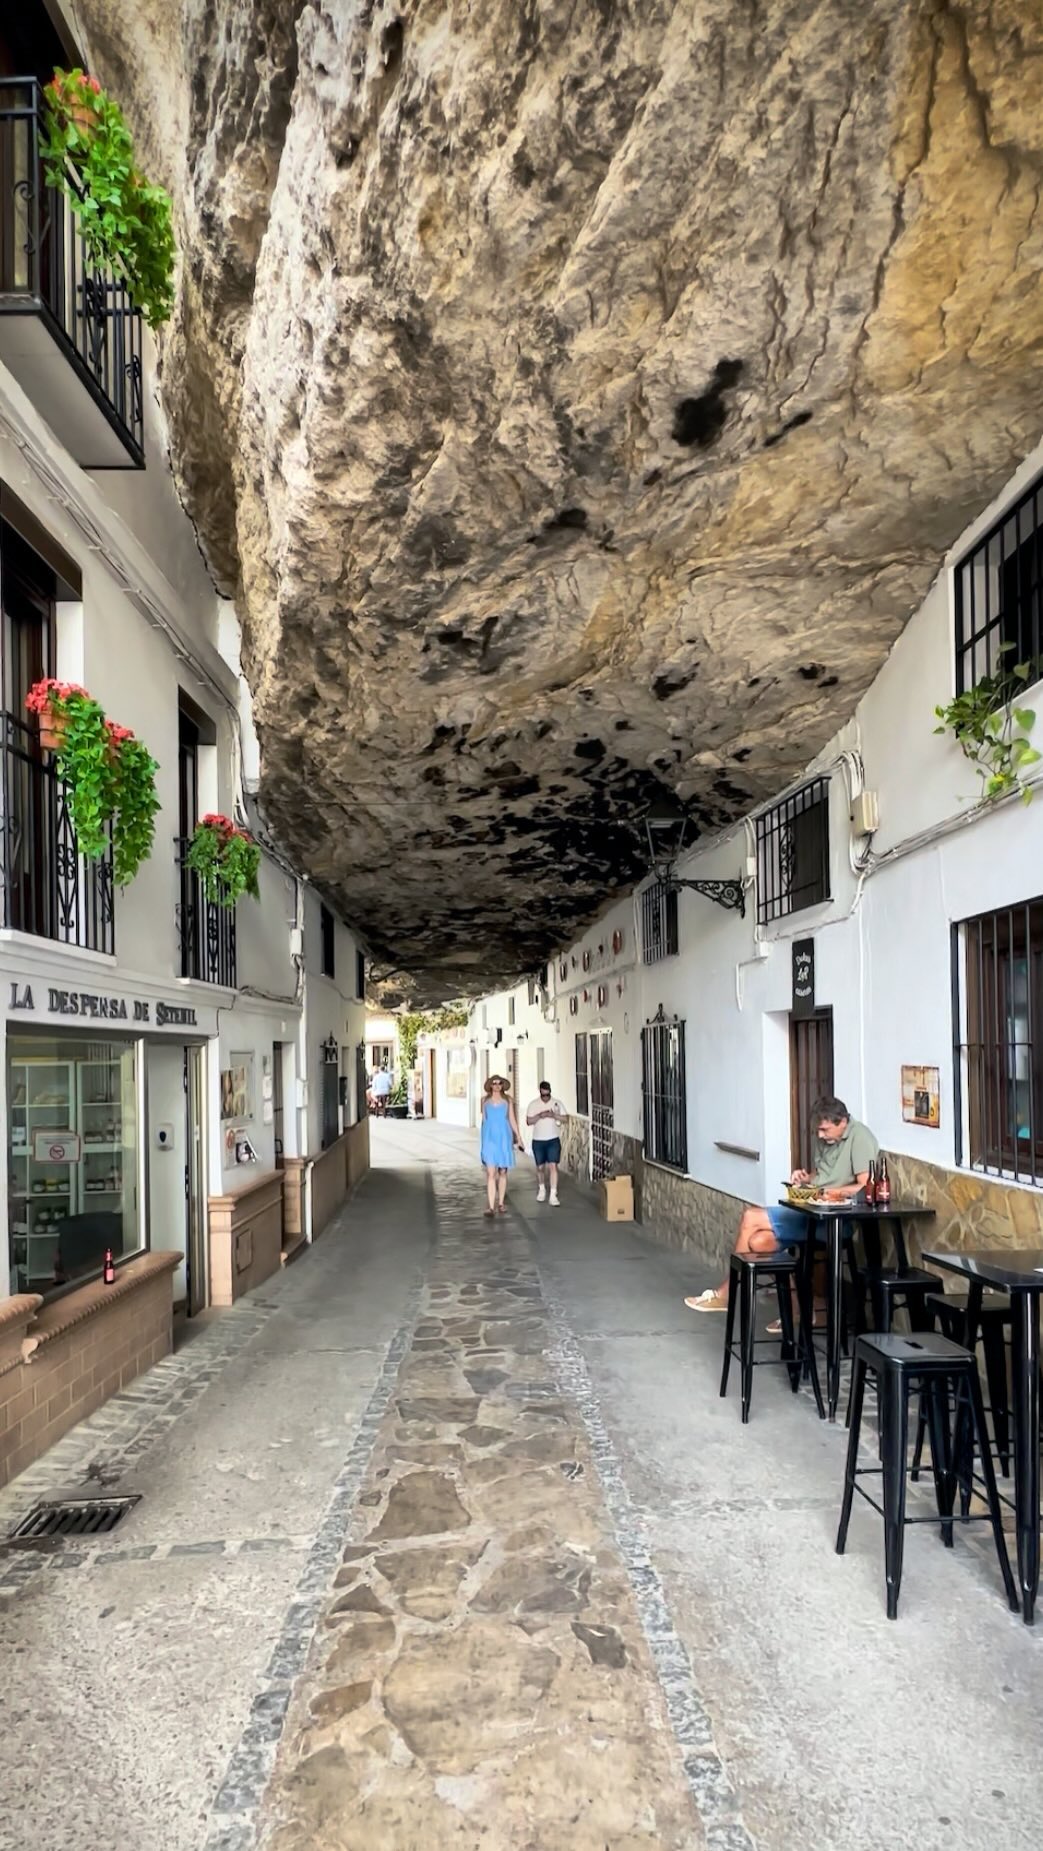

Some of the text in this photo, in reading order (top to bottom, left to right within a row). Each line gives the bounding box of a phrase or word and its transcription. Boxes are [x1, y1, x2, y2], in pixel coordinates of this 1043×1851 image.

[9, 983, 35, 1010] LA
[48, 989, 128, 1019] DESPENSA
[133, 1001, 150, 1022] DE
